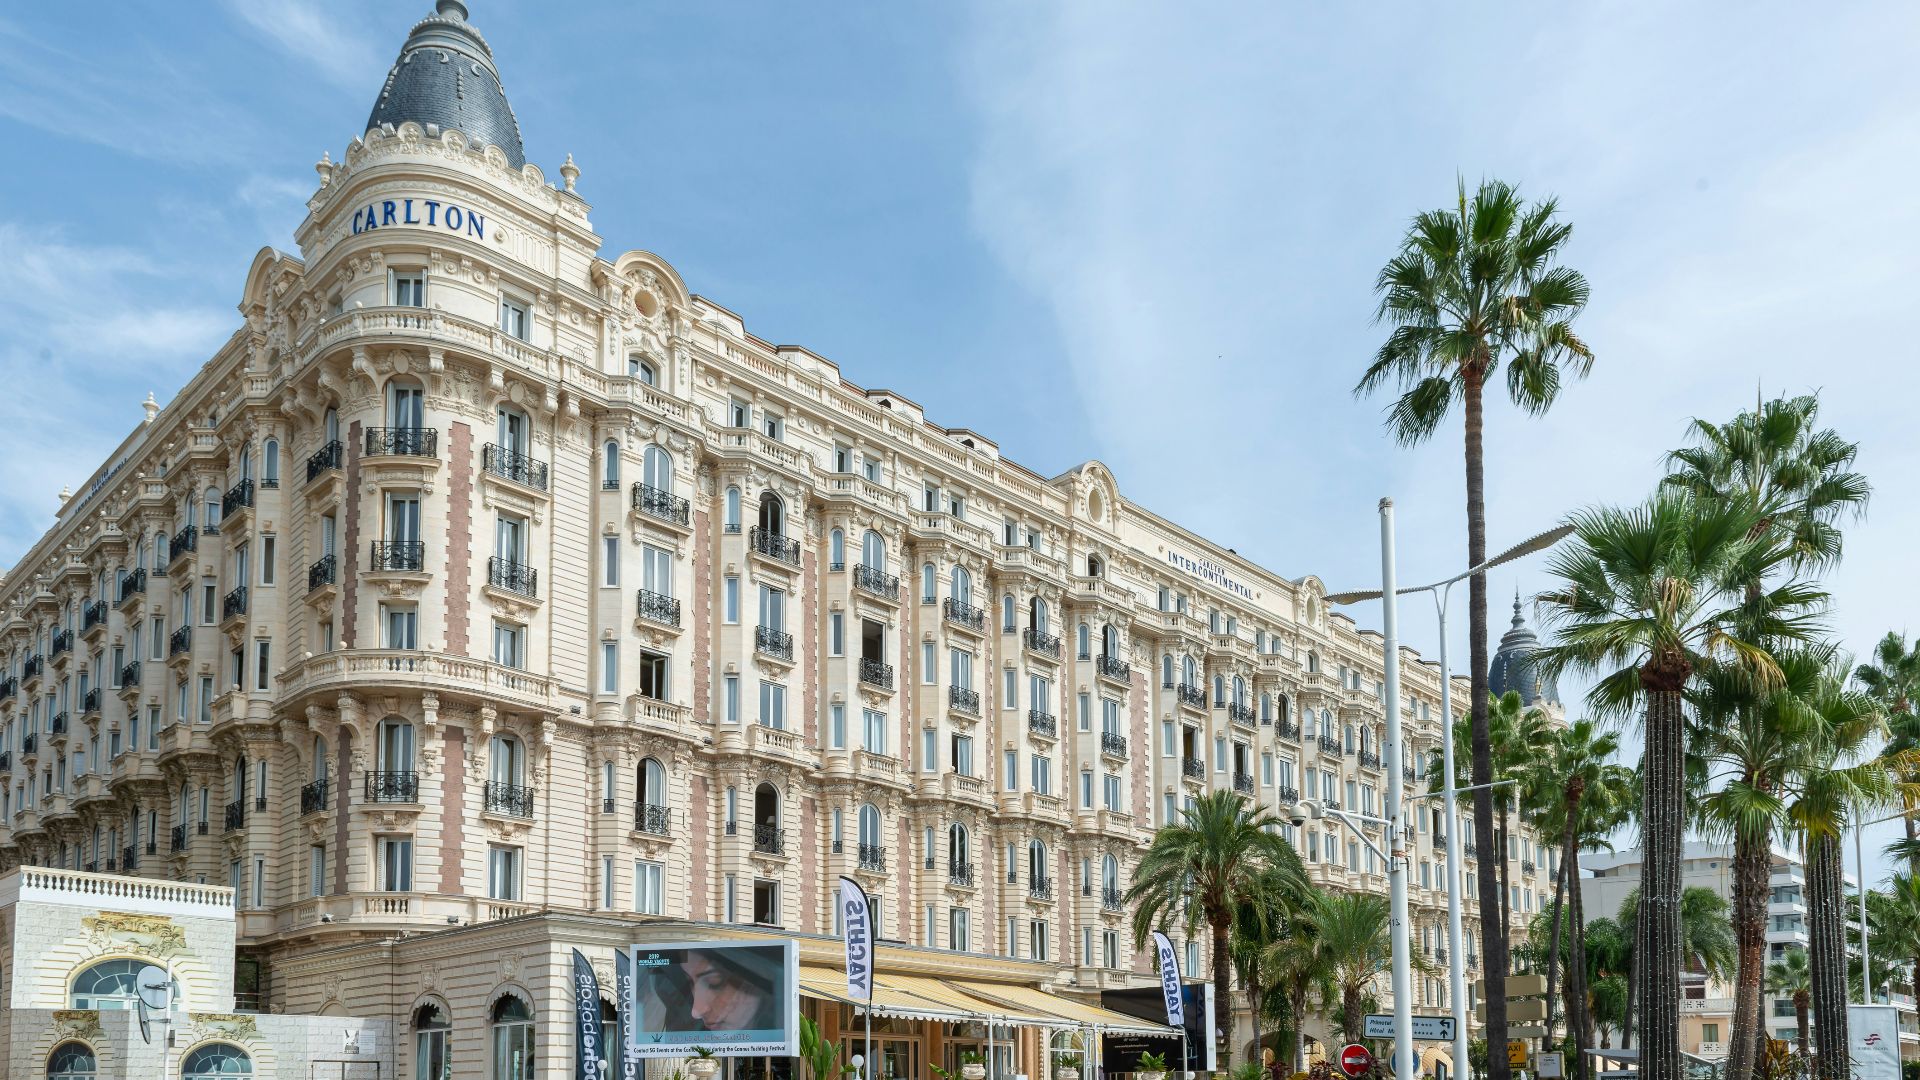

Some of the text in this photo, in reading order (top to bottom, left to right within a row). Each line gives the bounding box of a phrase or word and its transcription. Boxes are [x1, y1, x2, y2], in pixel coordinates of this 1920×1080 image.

[353, 199, 485, 240] CARLTON
[1168, 551, 1254, 600] INTERCONTINENTAL
[1199, 558, 1225, 575] CARLTON
